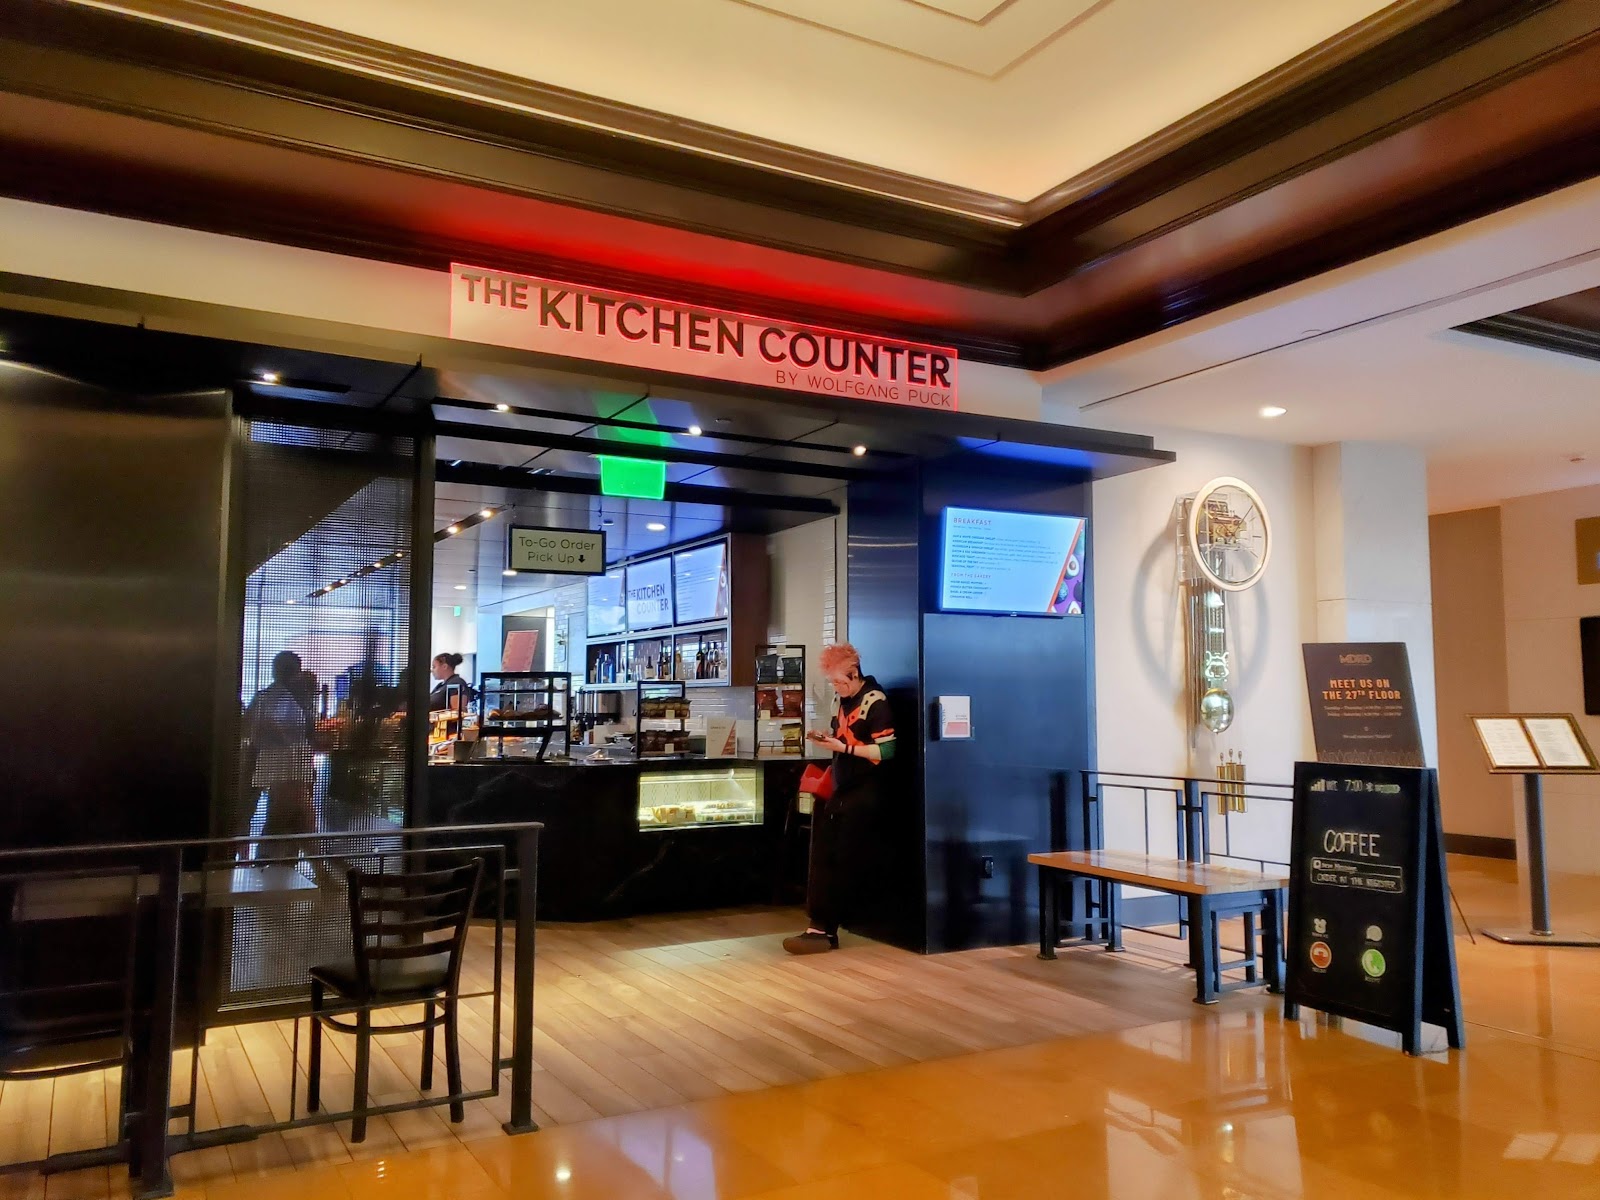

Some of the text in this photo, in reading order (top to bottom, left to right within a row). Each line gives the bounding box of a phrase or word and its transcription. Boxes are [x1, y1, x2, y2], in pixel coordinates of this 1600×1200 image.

[461, 273, 951, 389] THE KITCHEN COUNTER
[776, 370, 951, 407] BY WOLFGANG PUCK
[953, 517, 991, 525] BREAKFAST
[519, 536, 595, 550] To-Go Order
[528, 551, 575, 564] Pick Up
[628, 583, 665, 600] THE KITCHEN
[636, 598, 669, 615] COUNTER
[1329, 679, 1390, 688] MEET US ON
[1322, 691, 1342, 700] THE
[1369, 691, 1401, 700] FLOOR
[1324, 829, 1381, 857] COFFEE
